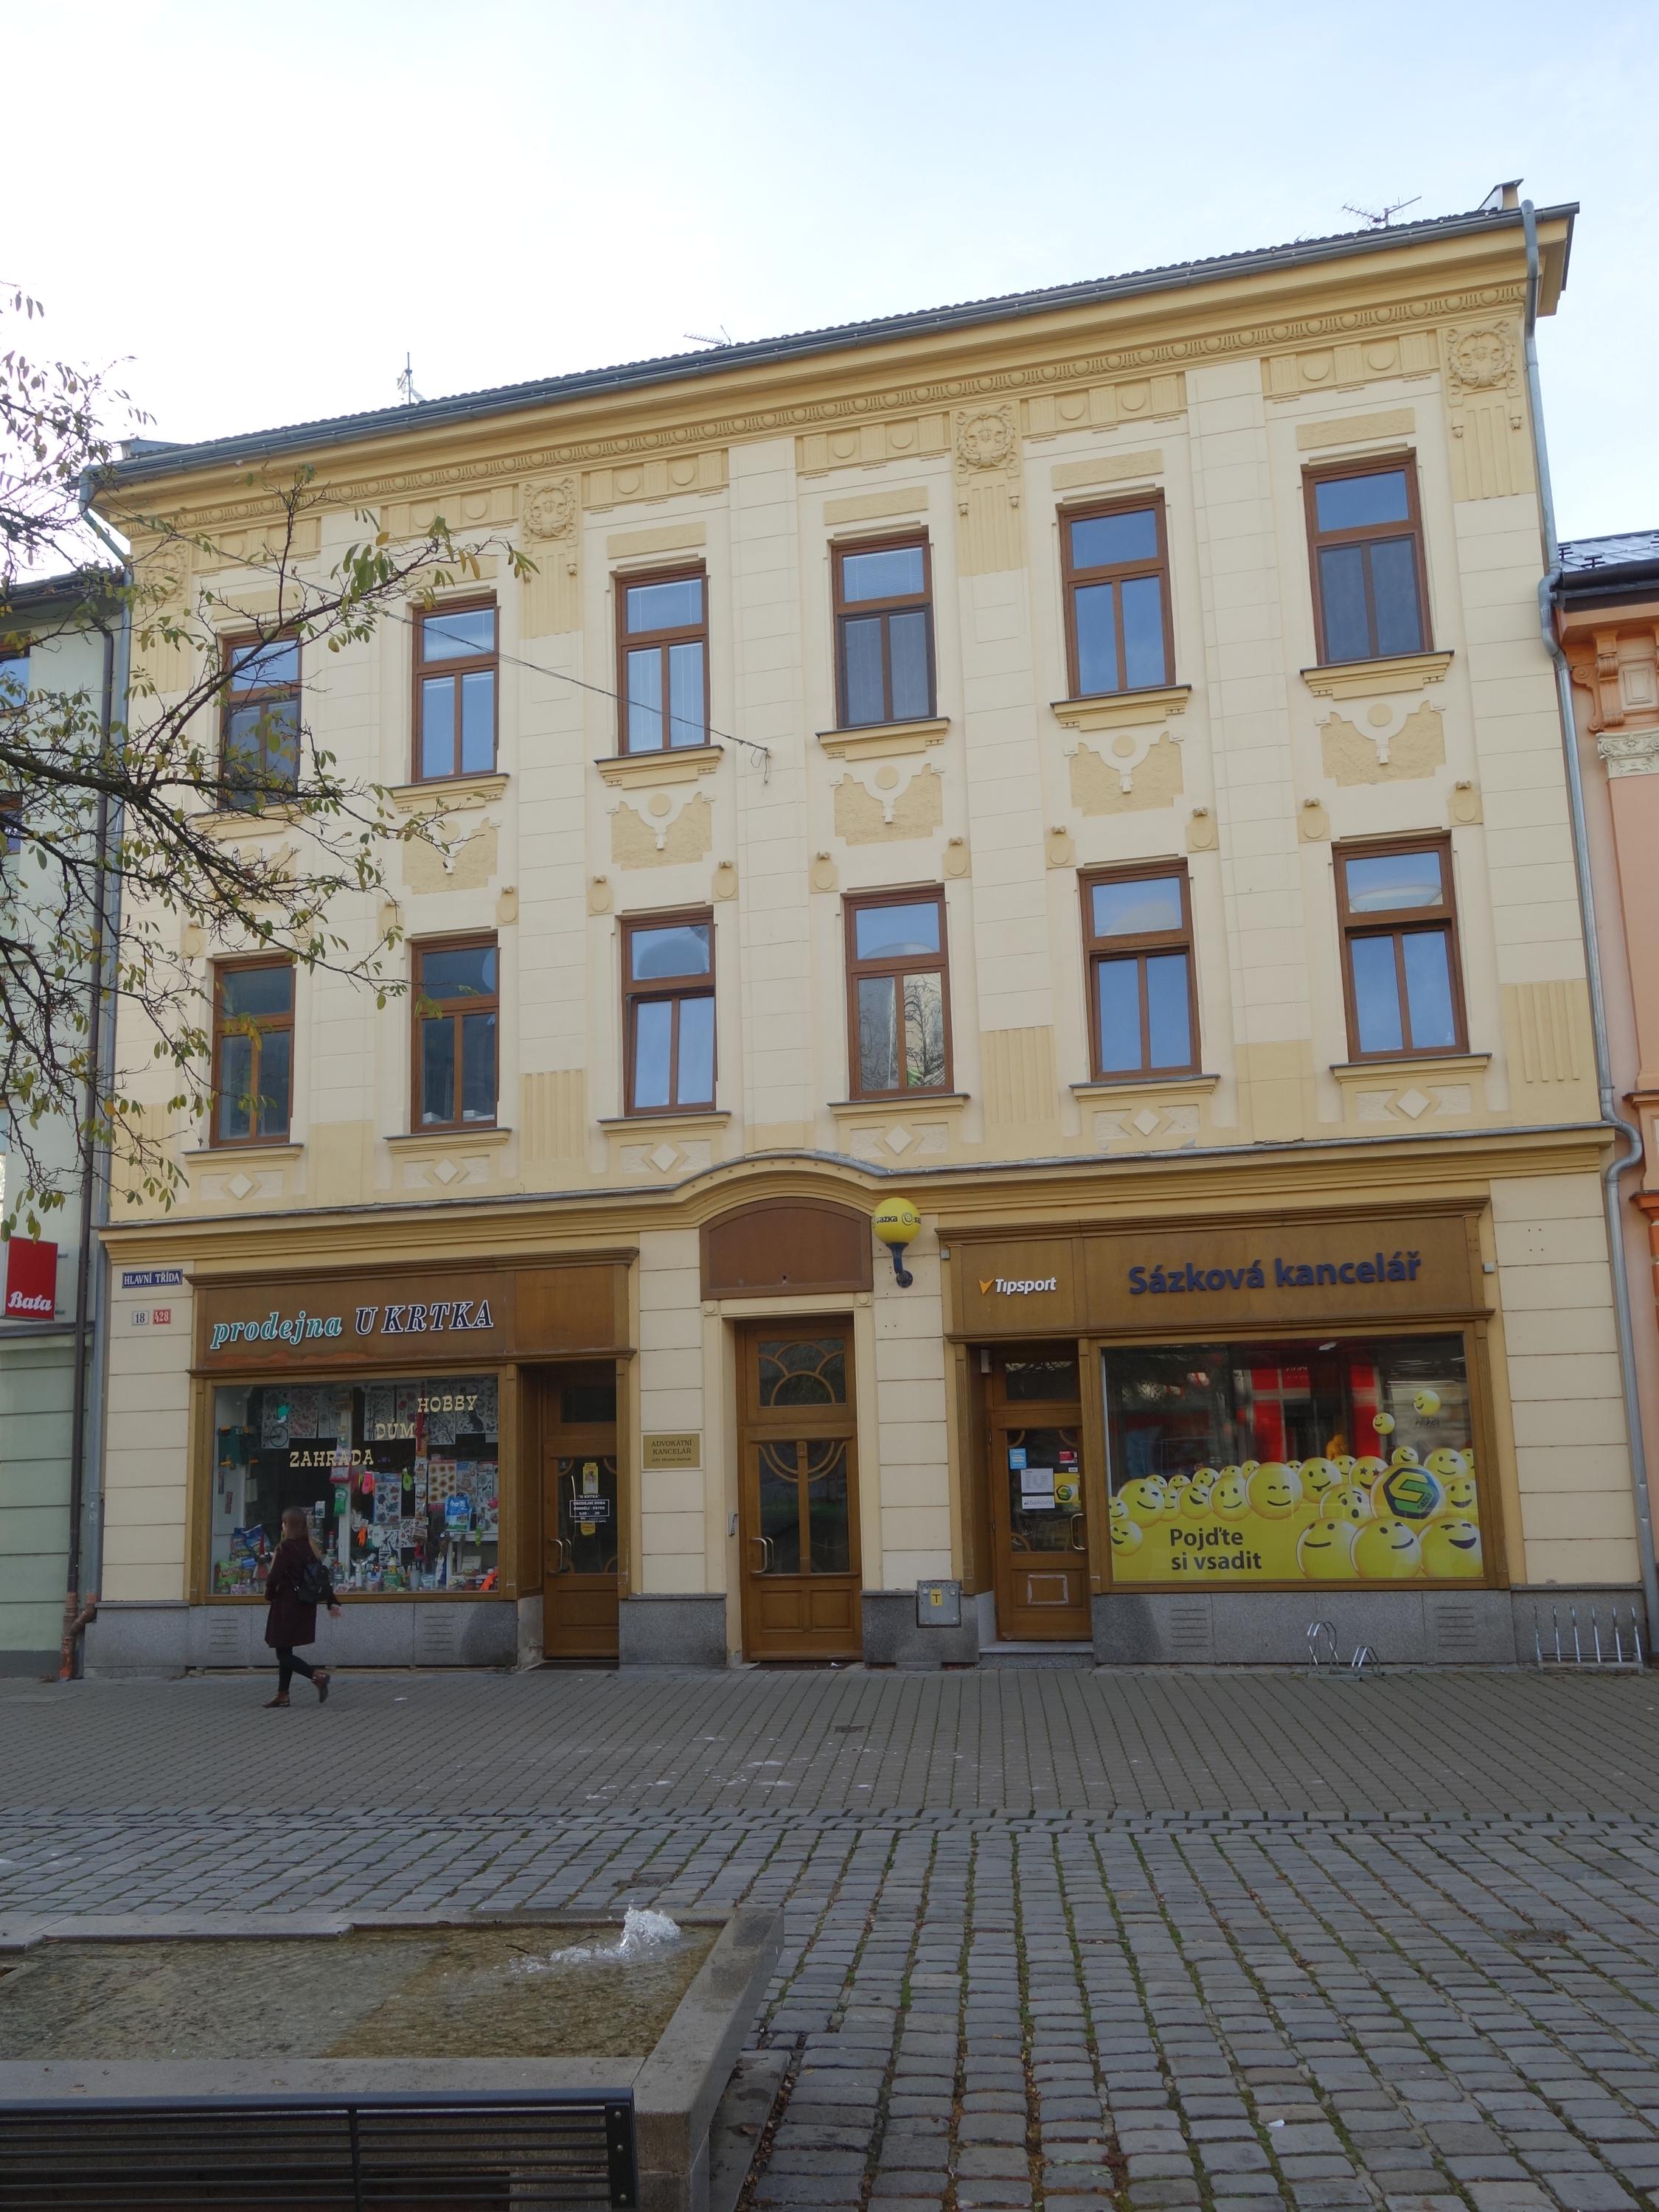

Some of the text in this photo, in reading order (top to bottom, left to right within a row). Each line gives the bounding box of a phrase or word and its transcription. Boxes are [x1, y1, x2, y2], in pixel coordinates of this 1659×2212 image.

[124, 1271, 180, 1285] HLAVNÍ TŘÍDA
[1128, 1251, 1421, 1295] Sázková kancelář
[995, 1277, 1057, 1295] Tipsport
[135, 1312, 145, 1323] 18
[154, 1310, 170, 1322] 428
[210, 1300, 494, 1349] prodejna U KRTKA
[417, 1395, 478, 1413] HOBBY
[375, 1418, 415, 1439] DŮM
[289, 1449, 375, 1467] ZAHRADA
[1170, 1527, 1243, 1551] Pojďte
[1172, 1551, 1262, 1570] si vsadit
[932, 1594, 941, 1603] T
